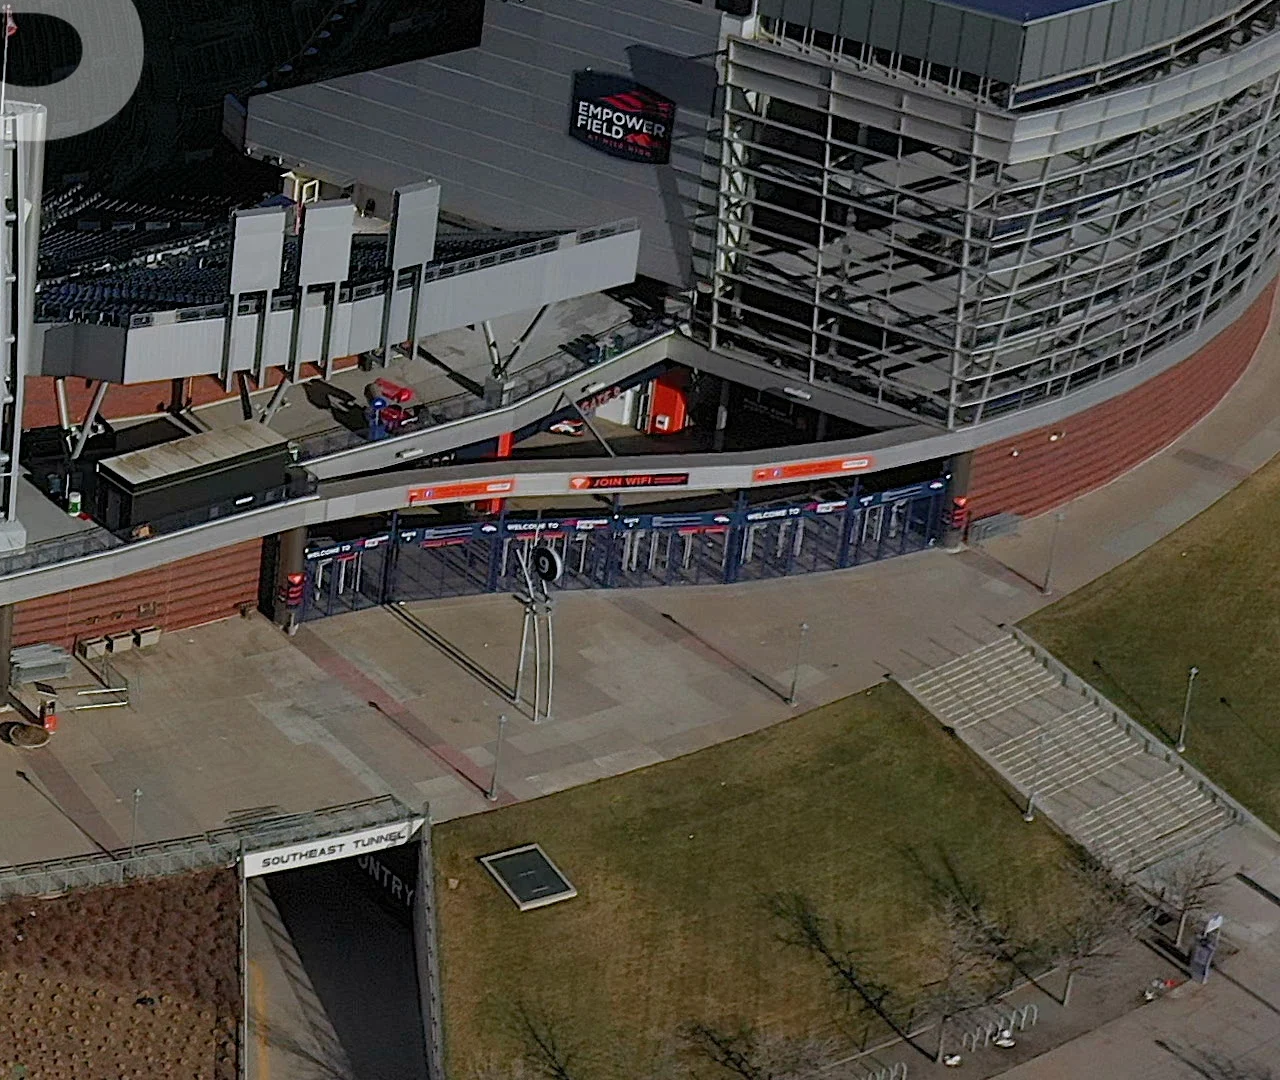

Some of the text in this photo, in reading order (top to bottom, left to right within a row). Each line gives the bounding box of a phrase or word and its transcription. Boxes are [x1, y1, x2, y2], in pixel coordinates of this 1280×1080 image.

[576, 114, 624, 140] FIELD
[578, 101, 666, 138] EMPOWER
[593, 477, 622, 488] JOIN
[626, 475, 652, 486] WIFI
[747, 507, 801, 521] WELCOME TO
[548, 521, 559, 530] TO
[306, 545, 352, 560] WELCOME TO
[540, 556, 550, 574] 9
[261, 831, 407, 868] SOUTHEAST TUNNEL
